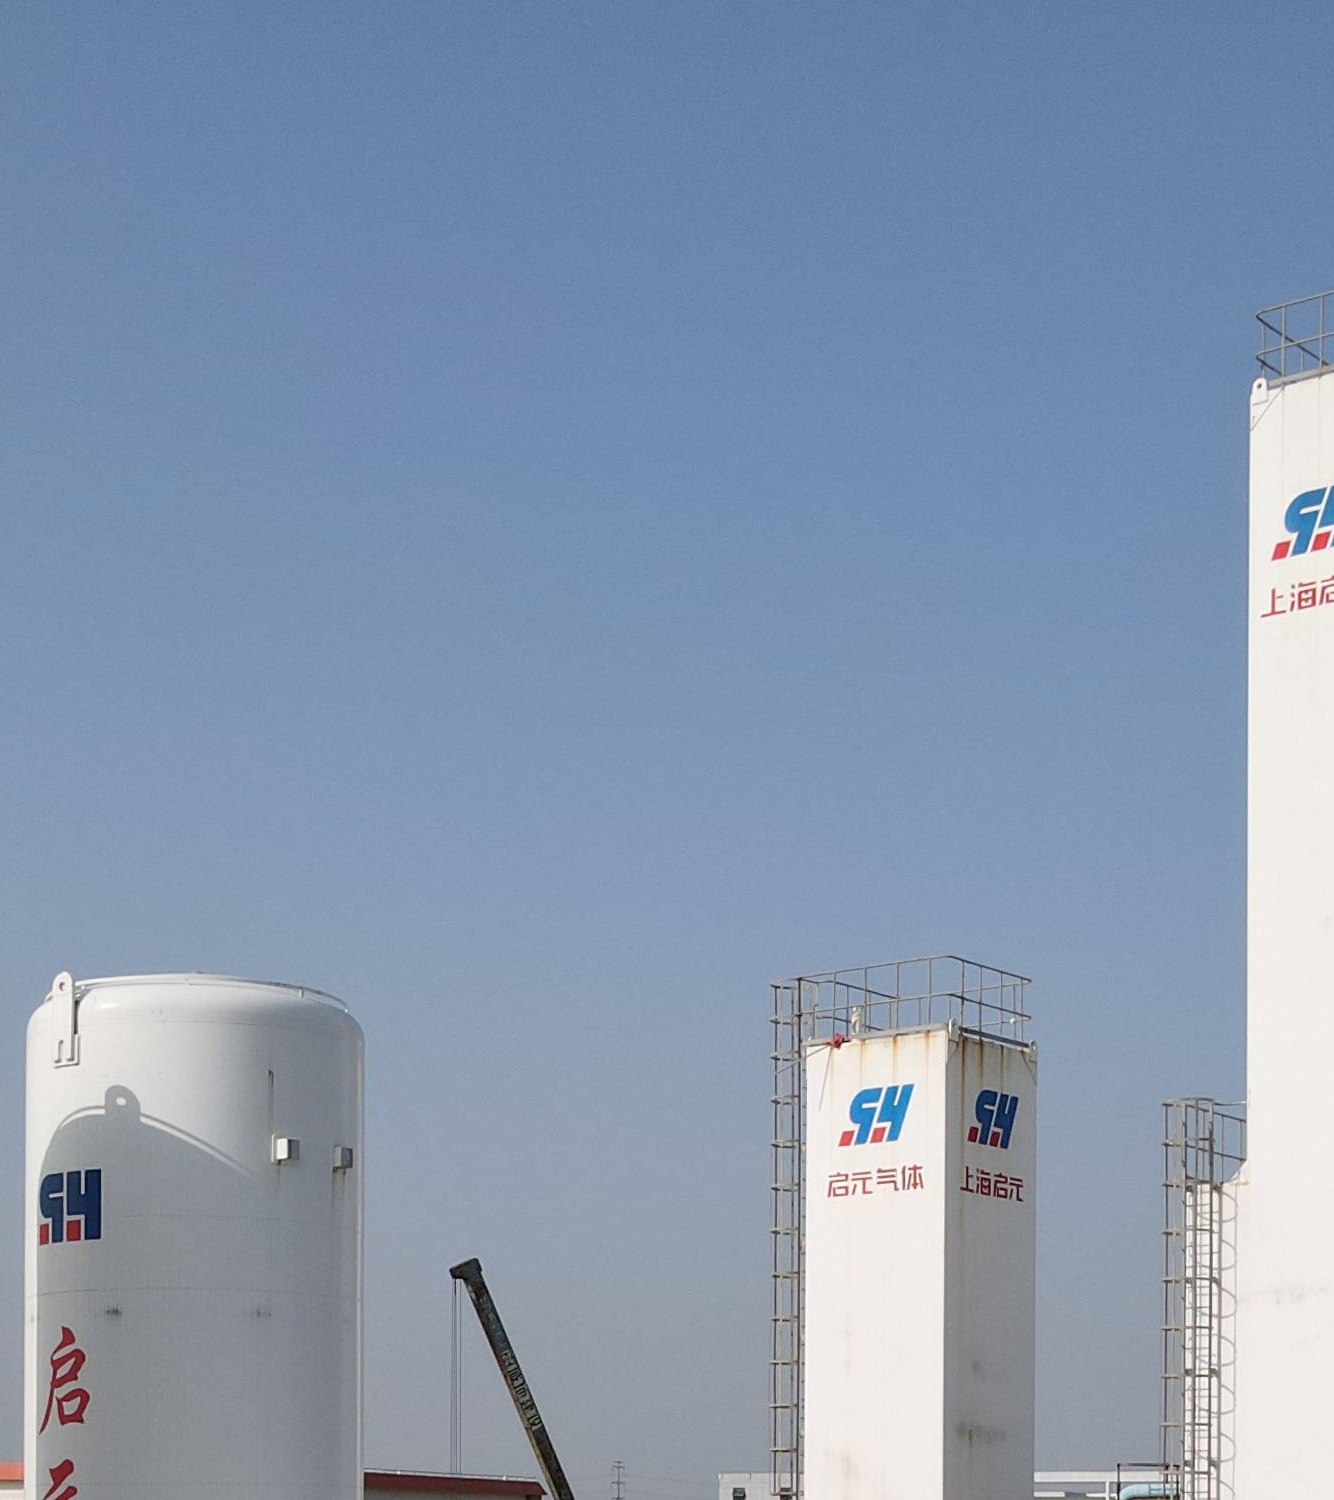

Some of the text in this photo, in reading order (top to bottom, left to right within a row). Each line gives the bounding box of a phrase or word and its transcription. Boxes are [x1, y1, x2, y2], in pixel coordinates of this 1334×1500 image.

[828, 1165, 924, 1198] 启元气体
[960, 1166, 1024, 1202] 上海启元
